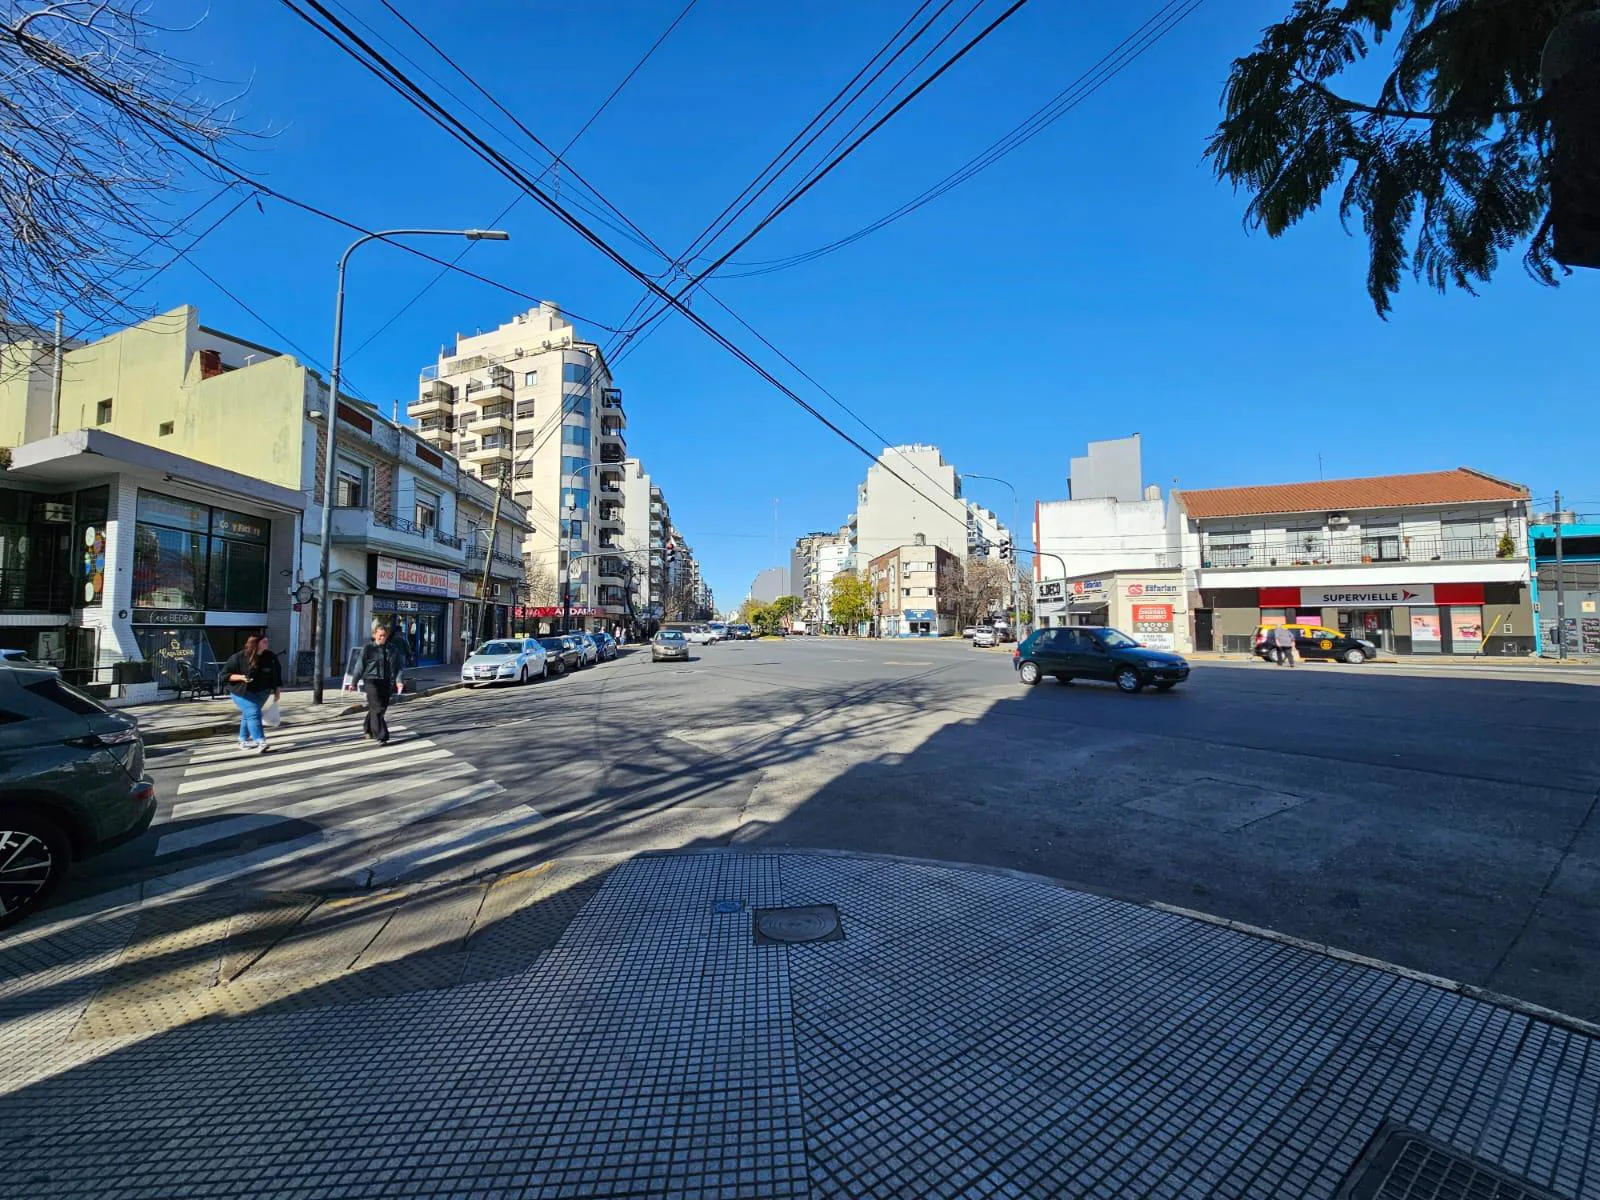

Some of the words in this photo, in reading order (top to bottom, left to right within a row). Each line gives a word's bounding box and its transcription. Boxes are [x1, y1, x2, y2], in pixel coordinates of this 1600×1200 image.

[397, 570, 428, 585] ELECTRO
[1323, 593, 1398, 602] SUPERVIELLE
[169, 613, 194, 623] BEDRA
